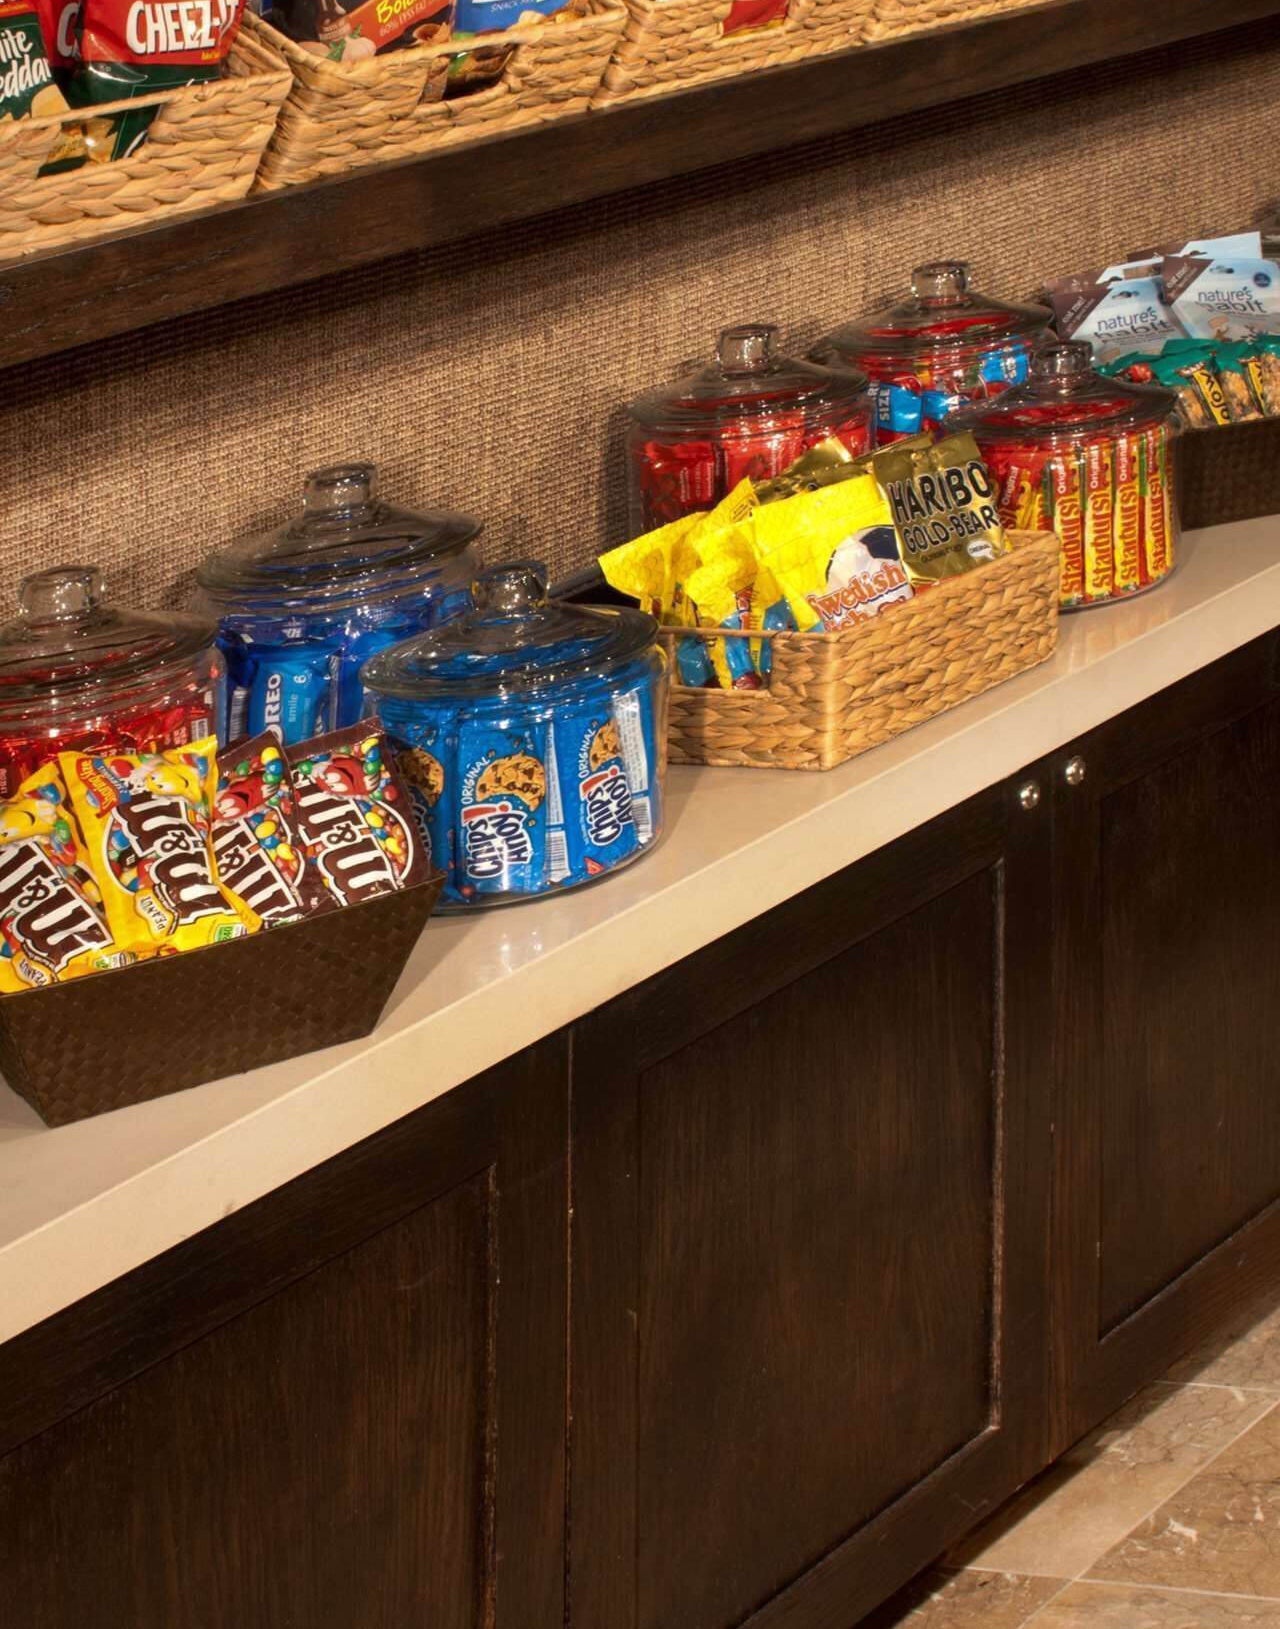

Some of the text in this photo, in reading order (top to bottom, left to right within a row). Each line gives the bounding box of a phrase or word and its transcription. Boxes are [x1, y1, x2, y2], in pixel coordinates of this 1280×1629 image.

[1196, 286, 1254, 304] nature's
[1097, 306, 1158, 332] nature's
[1089, 444, 1100, 490] Original
[887, 459, 995, 525] HARIBO
[1057, 496, 1082, 595] Starburst
[1089, 490, 1113, 589] Starburst
[1118, 483, 1138, 582] Starburst
[294, 674, 306, 685] 6
[287, 692, 299, 723] smile
[578, 720, 599, 779] ORIGINAL
[463, 757, 492, 804] ORIGINAL
[138, 891, 166, 931] PEANUT
